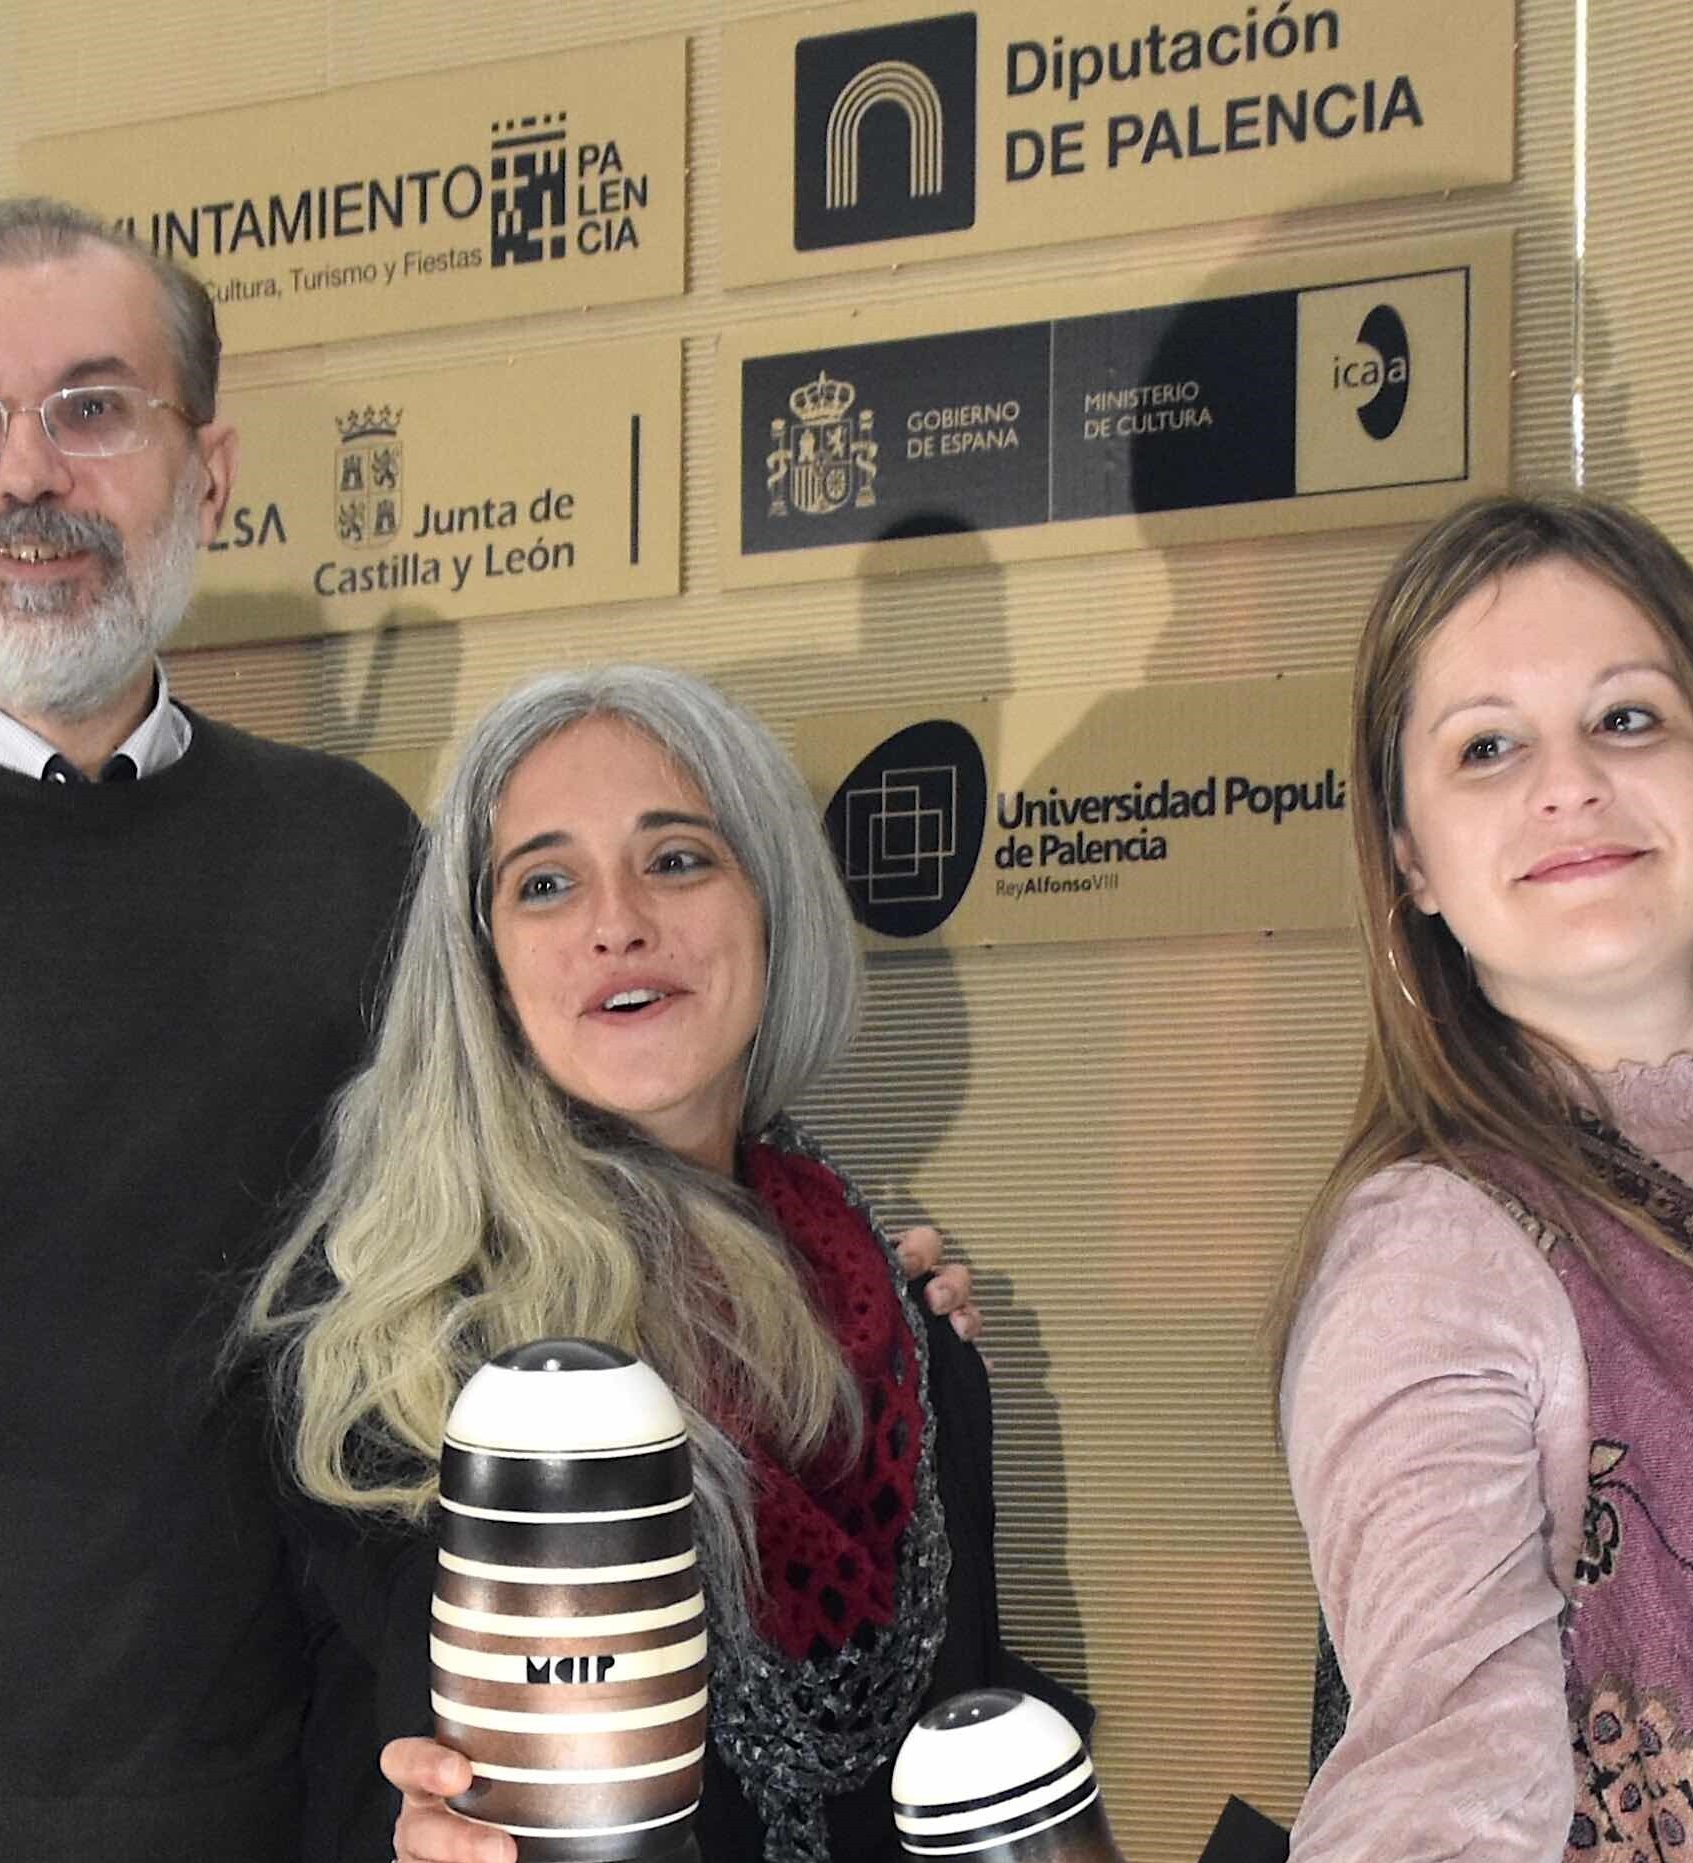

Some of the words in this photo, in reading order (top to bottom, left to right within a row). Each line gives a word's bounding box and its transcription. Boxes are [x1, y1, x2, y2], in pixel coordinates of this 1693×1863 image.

[1007, 1, 1340, 100] Diputación
[1006, 120, 1085, 183] DE
[1108, 75, 1425, 168] PALENCIA
[112, 164, 483, 258] UNTAMIENTO
[290, 264, 377, 294] Turismo
[384, 259, 398, 285] y
[404, 247, 483, 278] Fiestas
[1333, 356, 1407, 389] icaa
[907, 401, 1020, 432] GOBIERNO
[1085, 381, 1200, 413] MINISTERIO
[1085, 419, 1111, 440] DE
[1117, 406, 1213, 437] CULTURA
[907, 437, 933, 459] DE
[413, 500, 517, 538] Junta
[529, 489, 575, 522] de
[314, 553, 441, 597] Castilla
[453, 554, 472, 591] y
[485, 537, 575, 577] León
[996, 777, 1217, 828] Universidad
[995, 836, 1032, 869] de
[1039, 827, 1167, 866] Palencia
